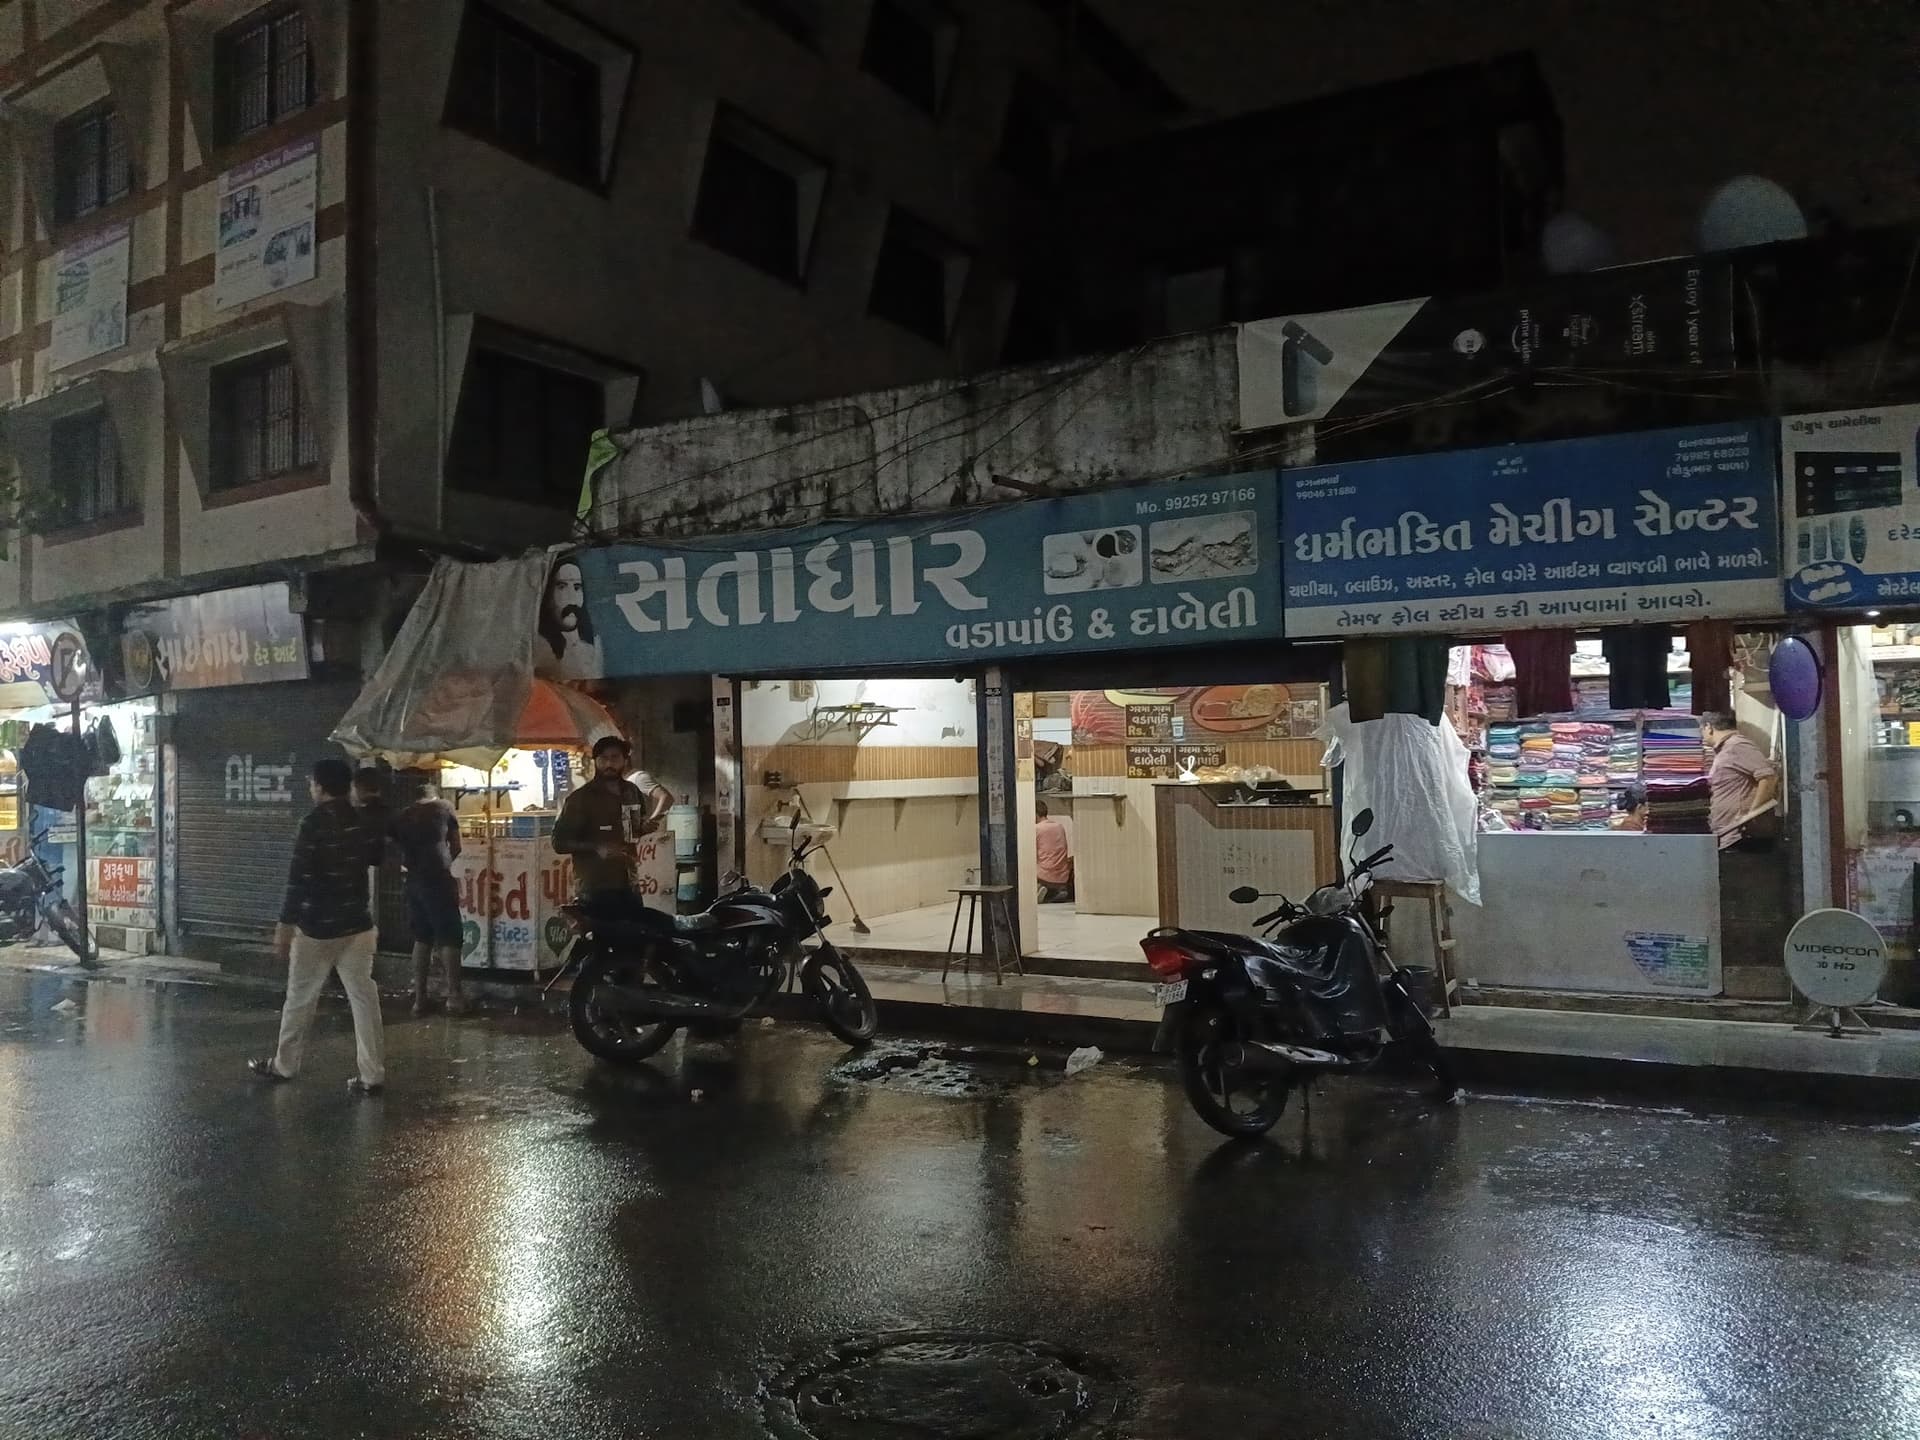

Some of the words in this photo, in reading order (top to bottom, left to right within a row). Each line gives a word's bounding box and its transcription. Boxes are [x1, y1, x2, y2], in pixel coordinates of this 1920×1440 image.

[1135, 500, 1161, 516] Mo.
[1165, 493, 1208, 512] 99252
[1211, 487, 1256, 506] 97166
[1633, 489, 1760, 537] સેન્ટર
[1675, 551, 1711, 571] ભાવે
[613, 528, 989, 634] સતાધાર
[1088, 608, 1117, 640] &
[1129, 587, 1258, 637] દાબેલી
[1335, 610, 1383, 628] તેમજ
[1391, 607, 1430, 627] ફોલ
[1495, 601, 1529, 618] કરી
[1538, 593, 1627, 617] આપવામાં
[1793, 943, 1880, 958] VIDEOCON
